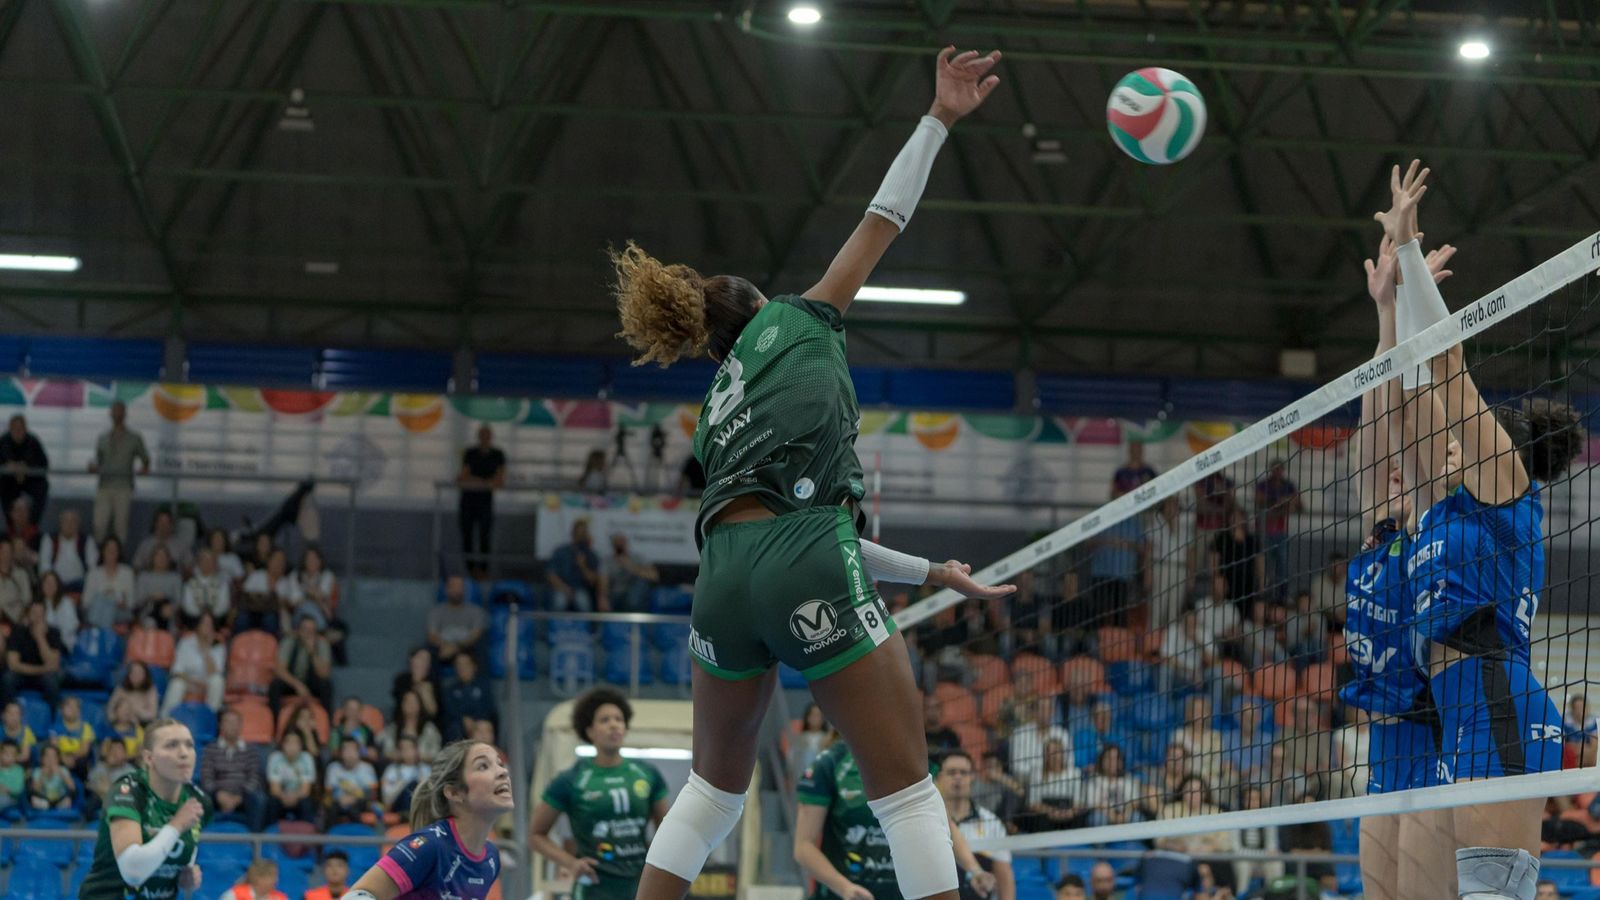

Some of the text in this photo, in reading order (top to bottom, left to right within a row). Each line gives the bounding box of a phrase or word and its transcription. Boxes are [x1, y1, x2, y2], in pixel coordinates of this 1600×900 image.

[1459, 294, 1507, 332] rfevb.com
[1353, 356, 1393, 389] rfevb.com
[864, 610, 878, 629] 8
[609, 787, 631, 814] 11
